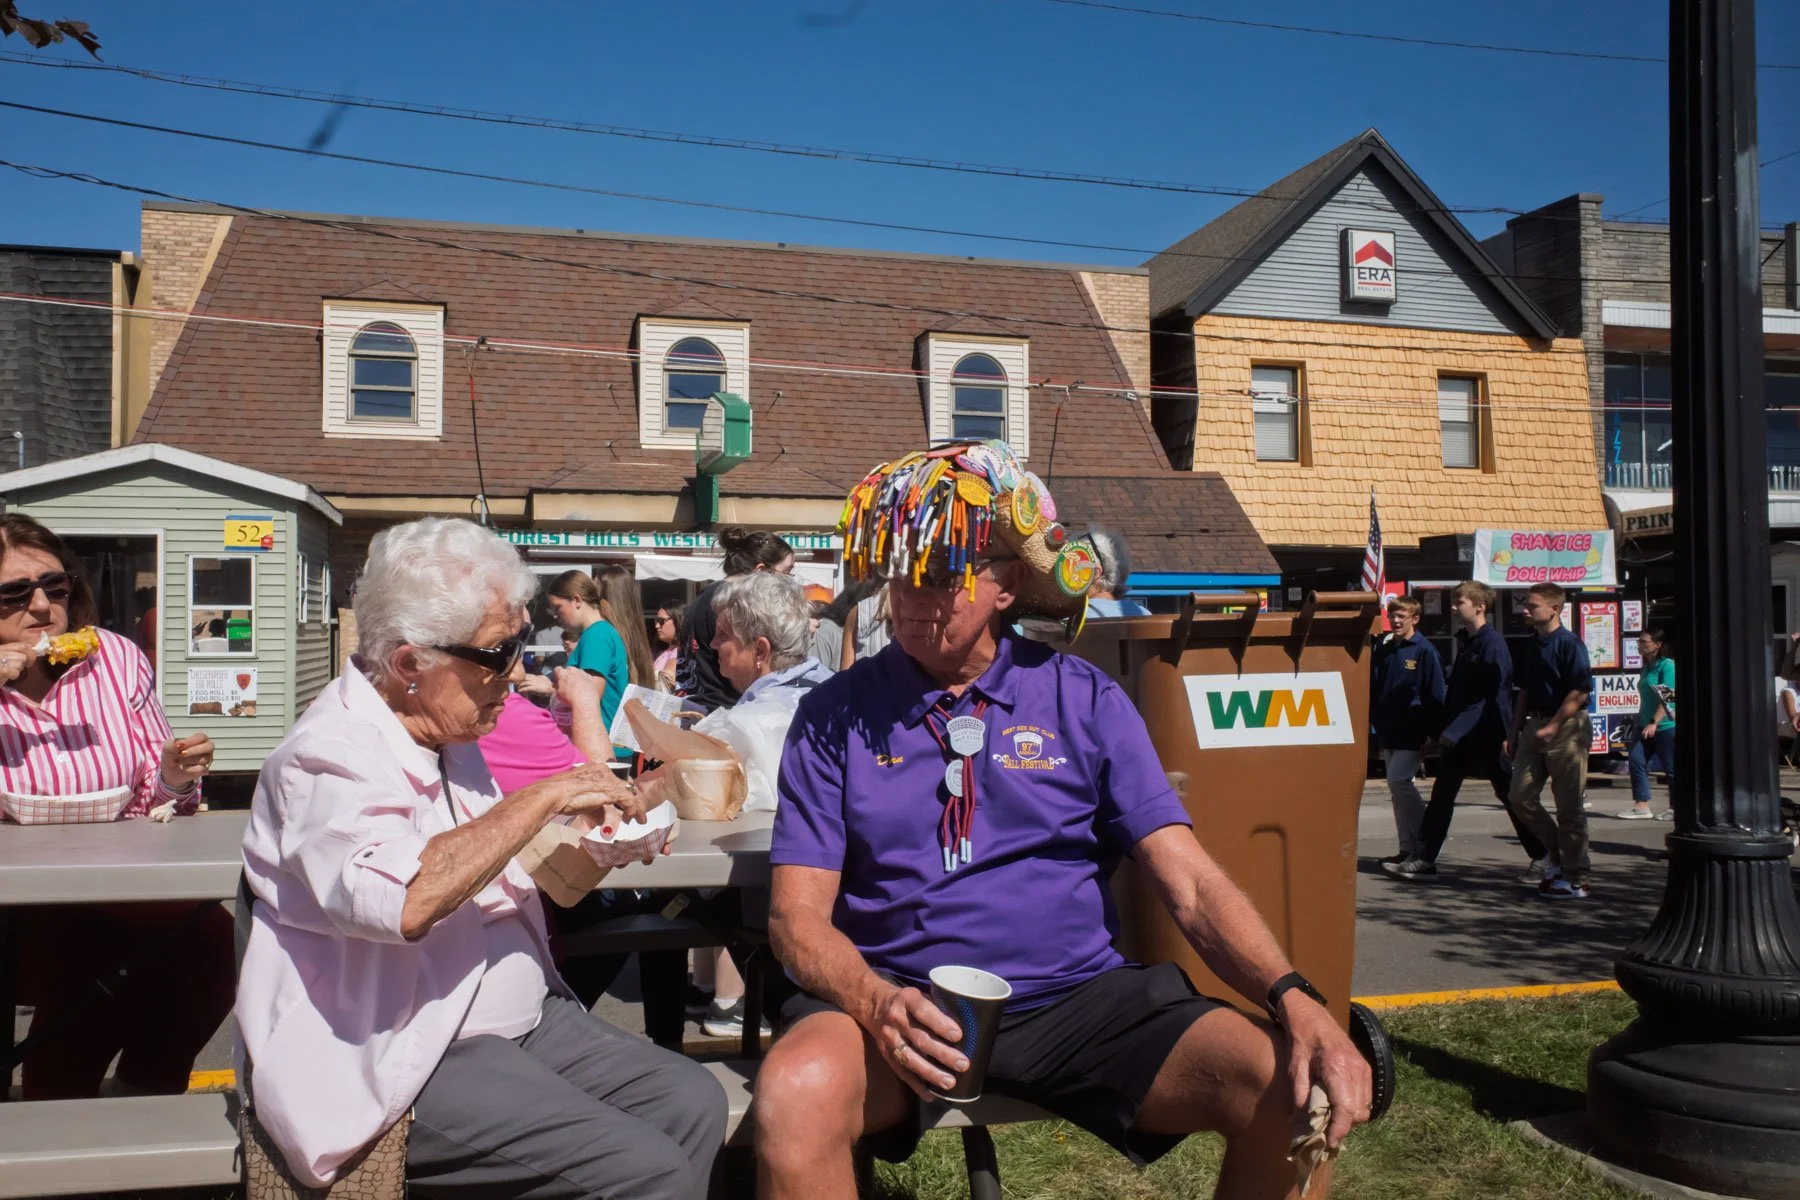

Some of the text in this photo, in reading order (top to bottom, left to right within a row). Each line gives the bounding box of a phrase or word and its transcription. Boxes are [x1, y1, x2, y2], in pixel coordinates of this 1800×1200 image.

[1357, 267, 1391, 281] ERA
[1626, 513, 1672, 531] PRIN
[236, 525, 260, 542] 52
[498, 531, 830, 548] FOREST HILLS WESLE OUTH
[1511, 533, 1592, 551] SHAVE ICE
[1506, 566, 1586, 582] DOLE WHIP
[1602, 677, 1635, 691] MAX
[1599, 695, 1639, 706] ENGLING
[1206, 689, 1330, 729] WM
[1041, 730, 1055, 740] CLUB
[1004, 754, 1054, 770] FALL FESTIVAL
